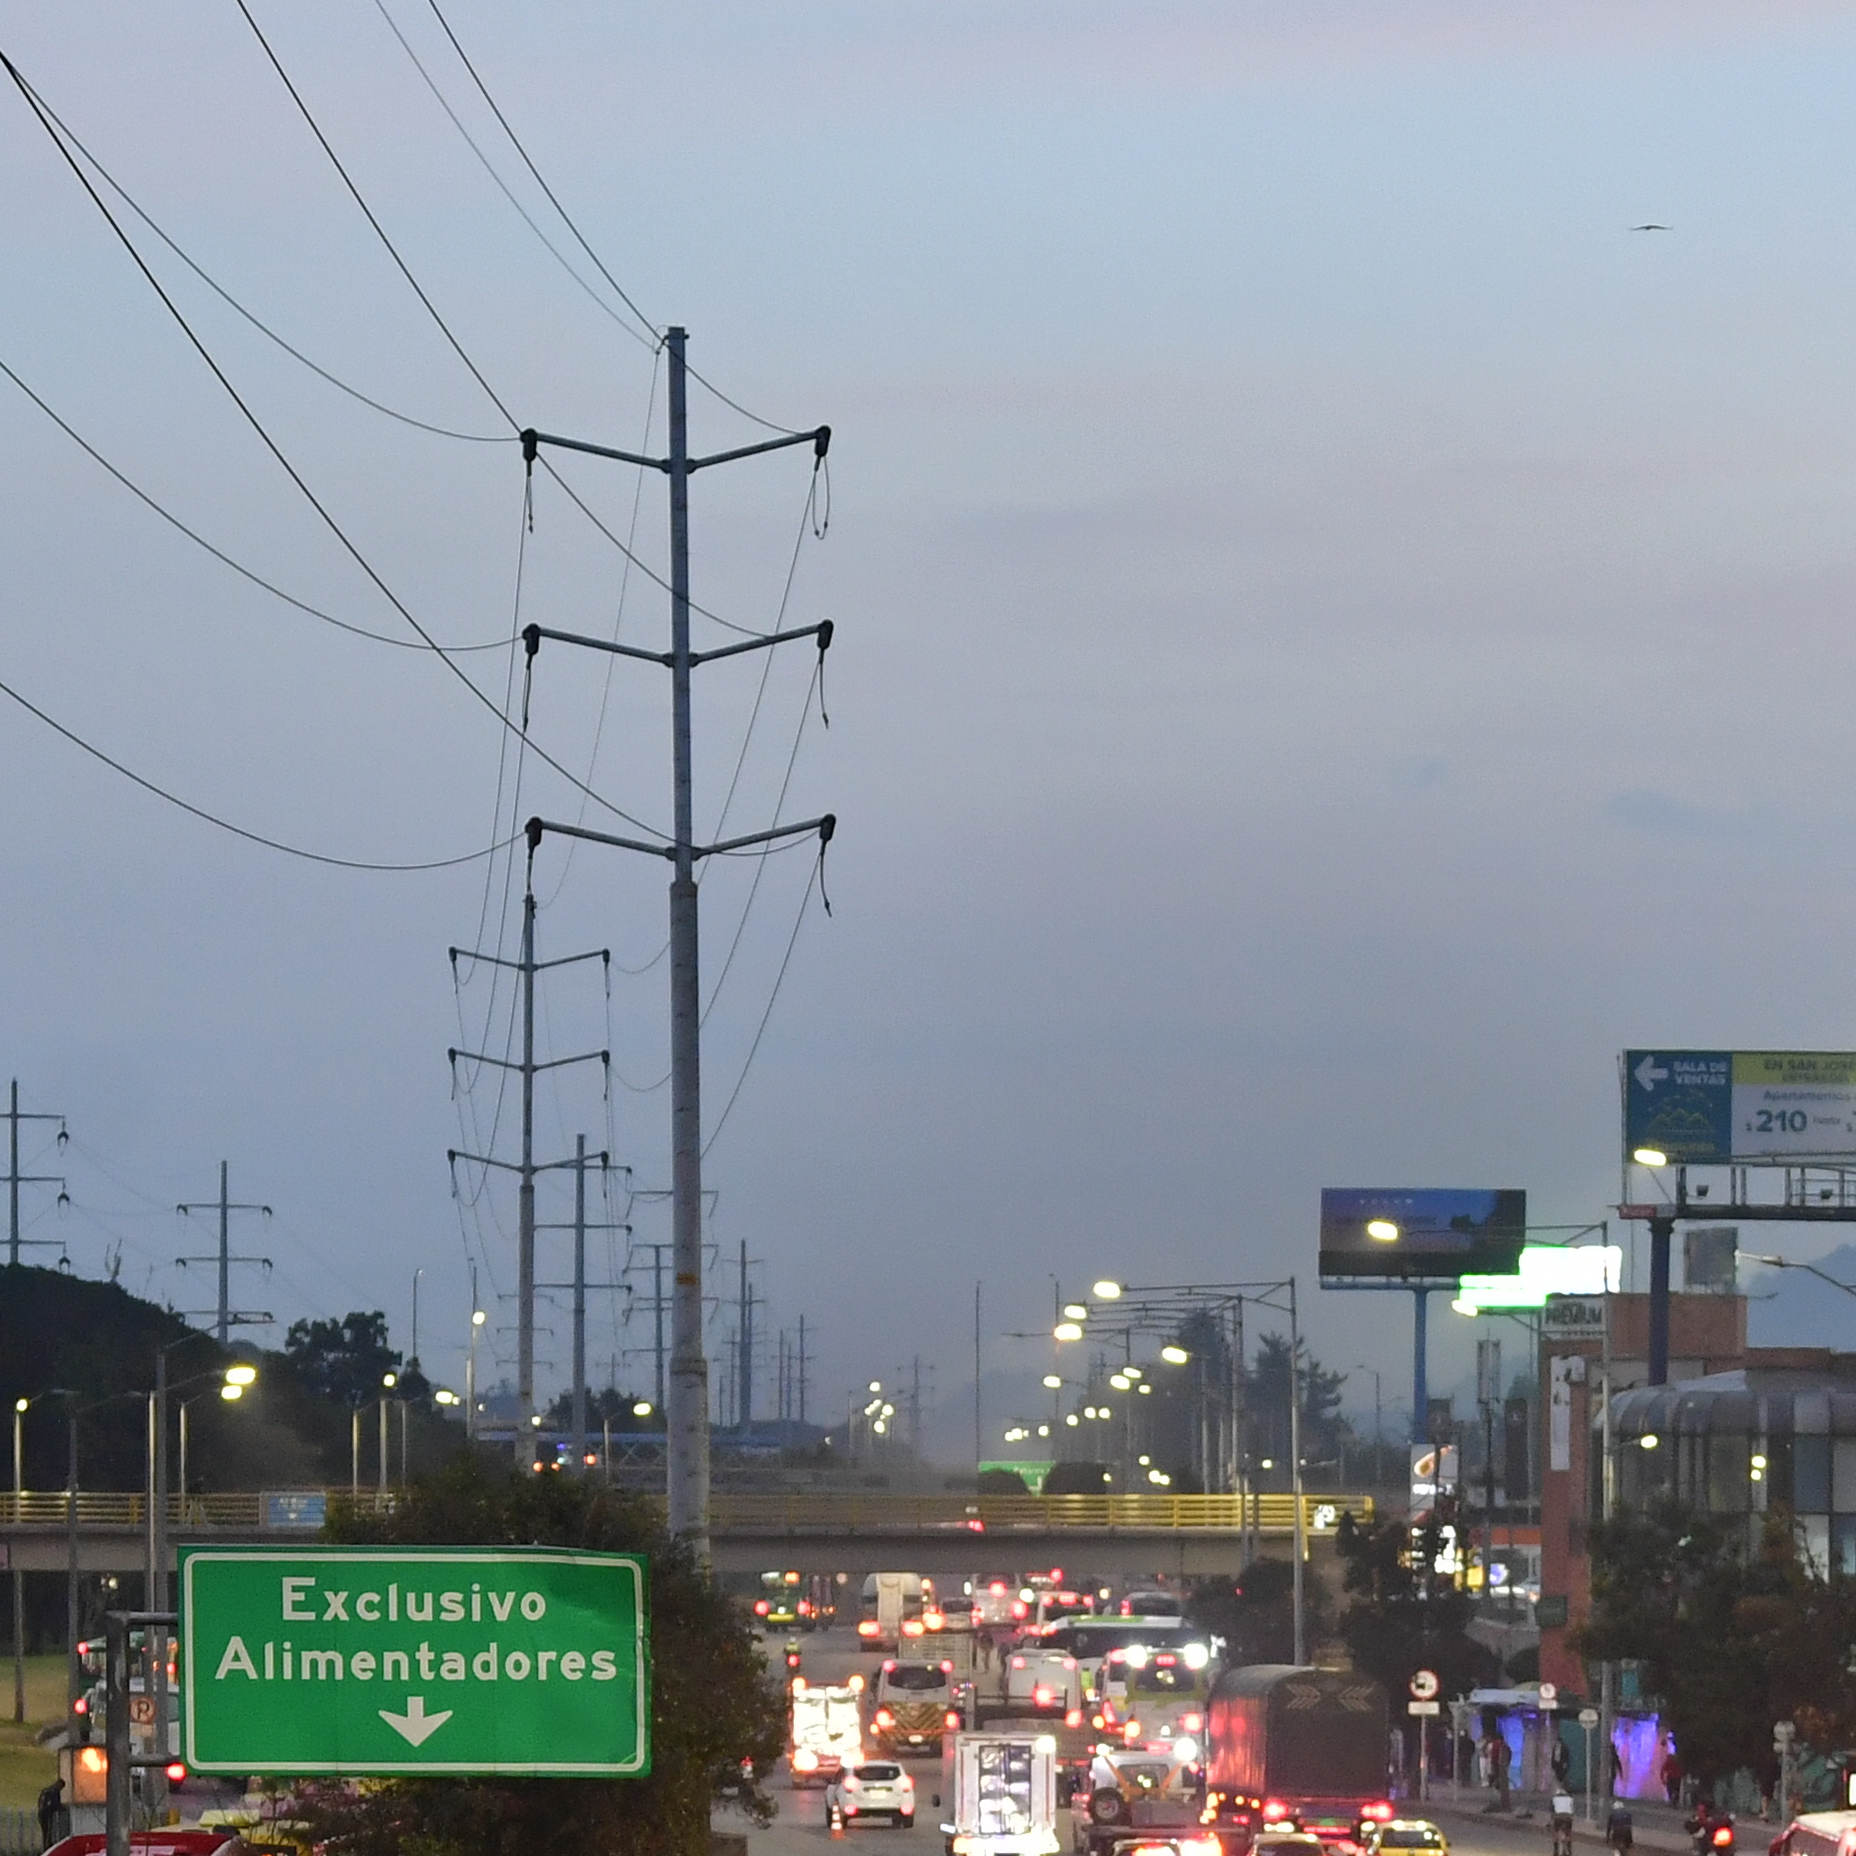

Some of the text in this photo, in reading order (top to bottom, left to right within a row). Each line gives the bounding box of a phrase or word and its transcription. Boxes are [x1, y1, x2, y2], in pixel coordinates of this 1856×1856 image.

[1675, 1074, 1727, 1085] VENTAS
[281, 1576, 547, 1622] Exclusivo
[214, 1635, 617, 1681] Alimentadores
